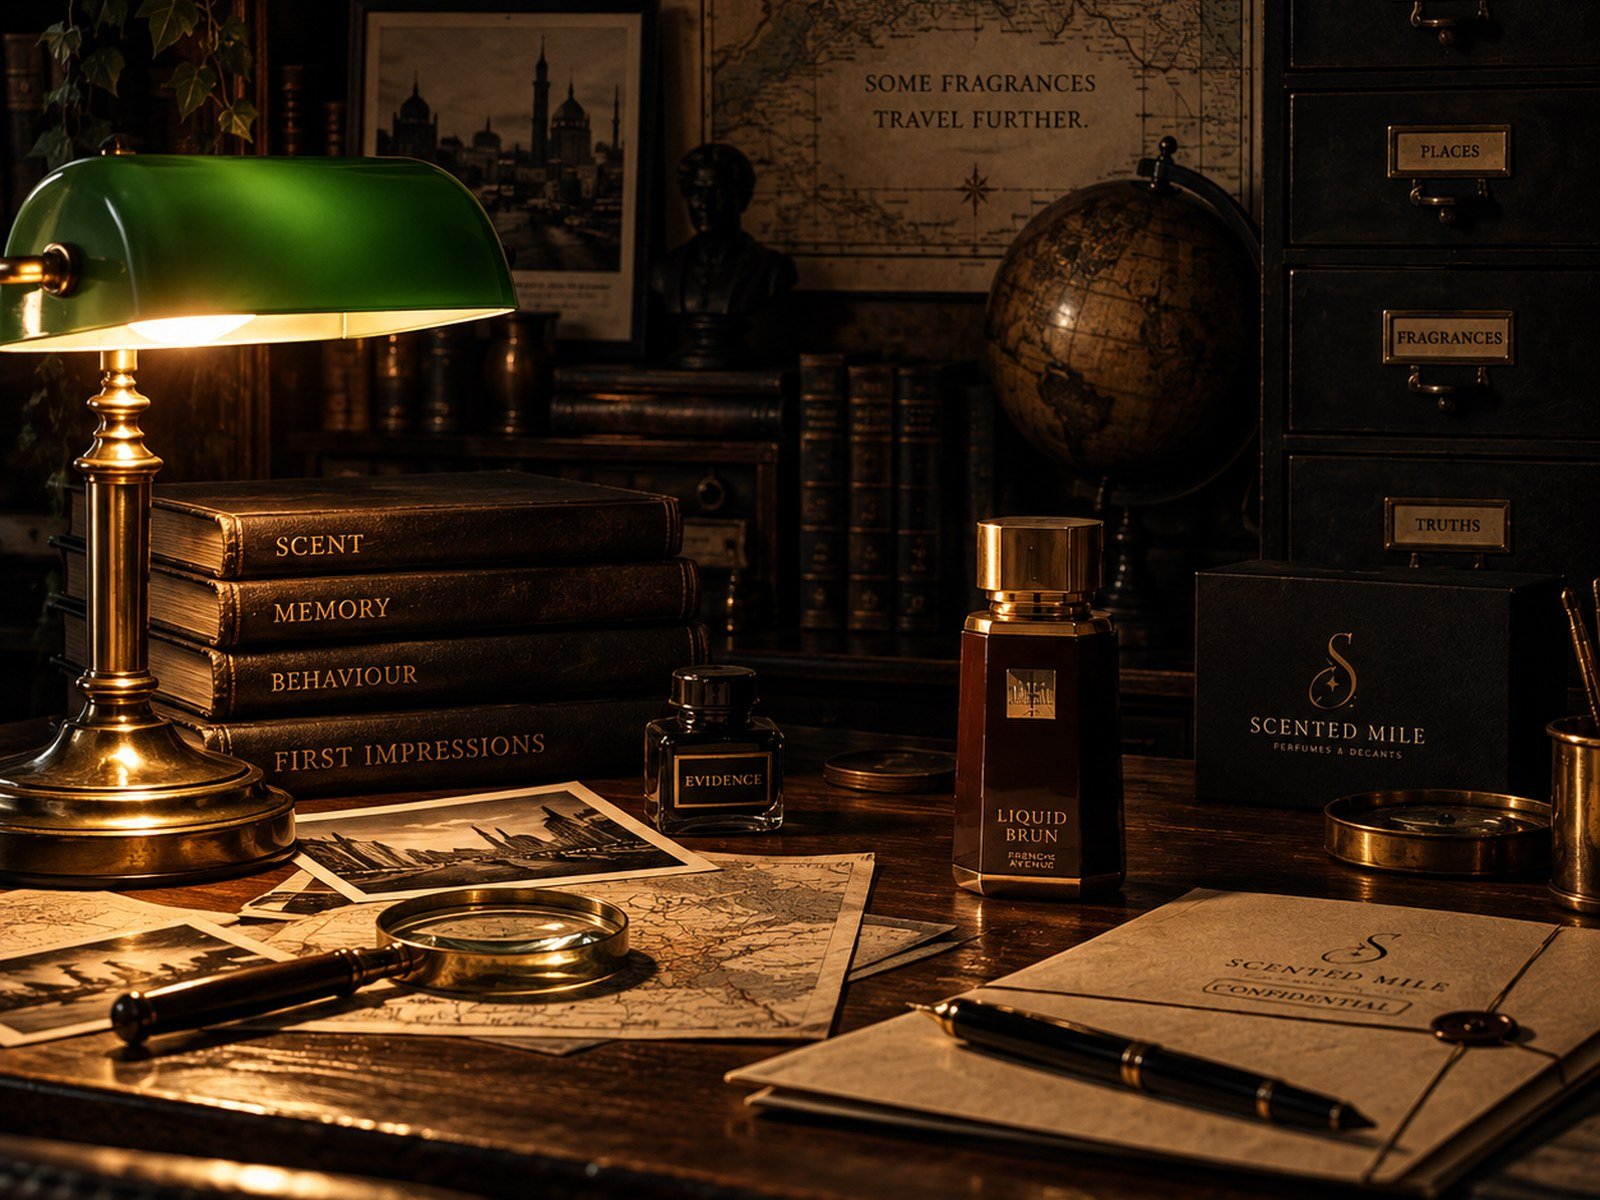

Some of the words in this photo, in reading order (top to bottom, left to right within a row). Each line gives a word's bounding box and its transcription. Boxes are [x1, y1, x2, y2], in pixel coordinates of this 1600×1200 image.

[865, 74, 932, 93] SOME
[941, 74, 1096, 93] FRAGRANCES
[873, 110, 964, 129] TRAVEL
[973, 110, 1089, 129] FURTHER.
[1421, 145, 1480, 158] PLACES
[1397, 331, 1503, 345] FRAGRANCES
[1415, 518, 1481, 532] TRUTHS
[275, 534, 364, 557] SCENT
[273, 597, 391, 623] MEMORY
[270, 665, 418, 693] BEHAVIOUR
[1250, 716, 1358, 740] SCENTED
[1368, 723, 1426, 745] MILE
[274, 746, 353, 773] FIRST
[364, 733, 545, 766] IMPRESSIONS
[1273, 741, 1332, 755] PERFUMES
[1349, 747, 1403, 760] DECANTS
[685, 774, 762, 788] EVIDENCE
[997, 809, 1067, 827] LIQUID
[1006, 828, 1058, 844] BRUN
[1224, 958, 1364, 982] SCENTED
[1373, 975, 1450, 993] MILE
[1212, 983, 1391, 1012] CONFIDENTIAL
